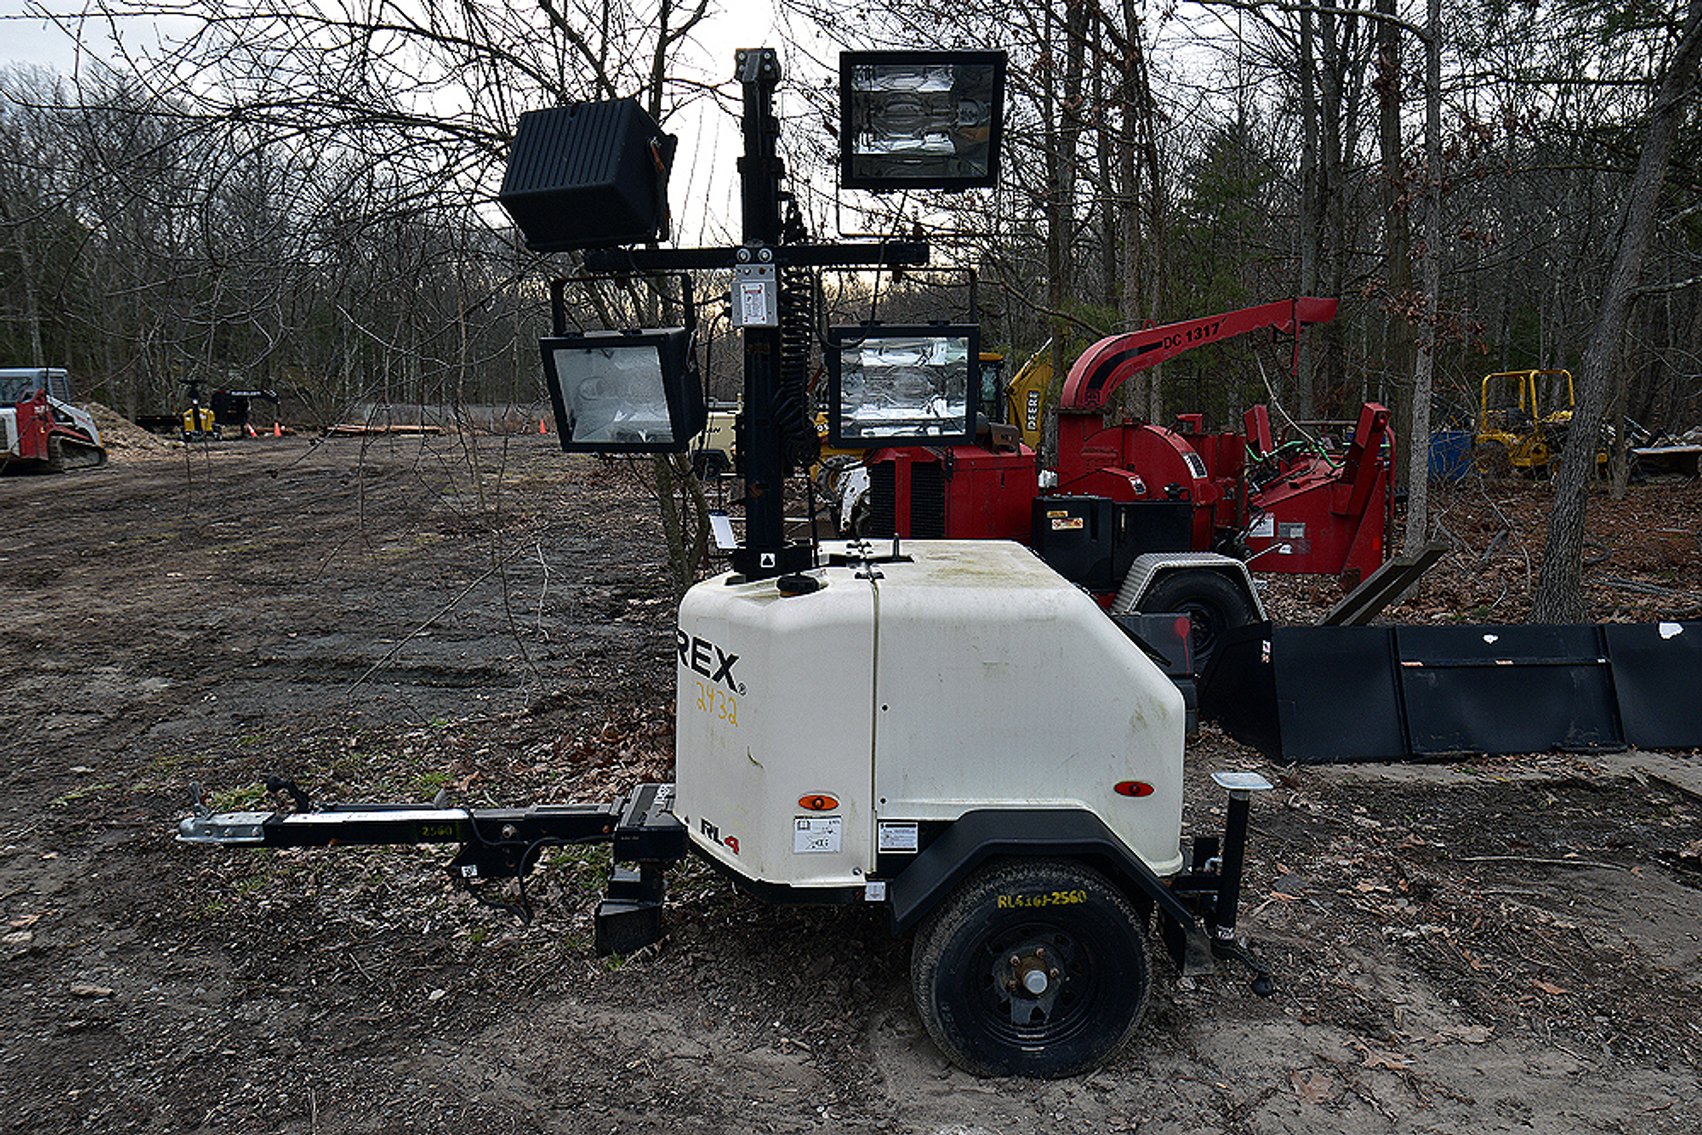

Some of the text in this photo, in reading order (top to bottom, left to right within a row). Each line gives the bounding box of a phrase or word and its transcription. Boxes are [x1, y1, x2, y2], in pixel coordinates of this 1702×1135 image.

[1163, 322, 1219, 349] DC 1317
[676, 627, 740, 694] REX
[696, 681, 739, 727] 2432
